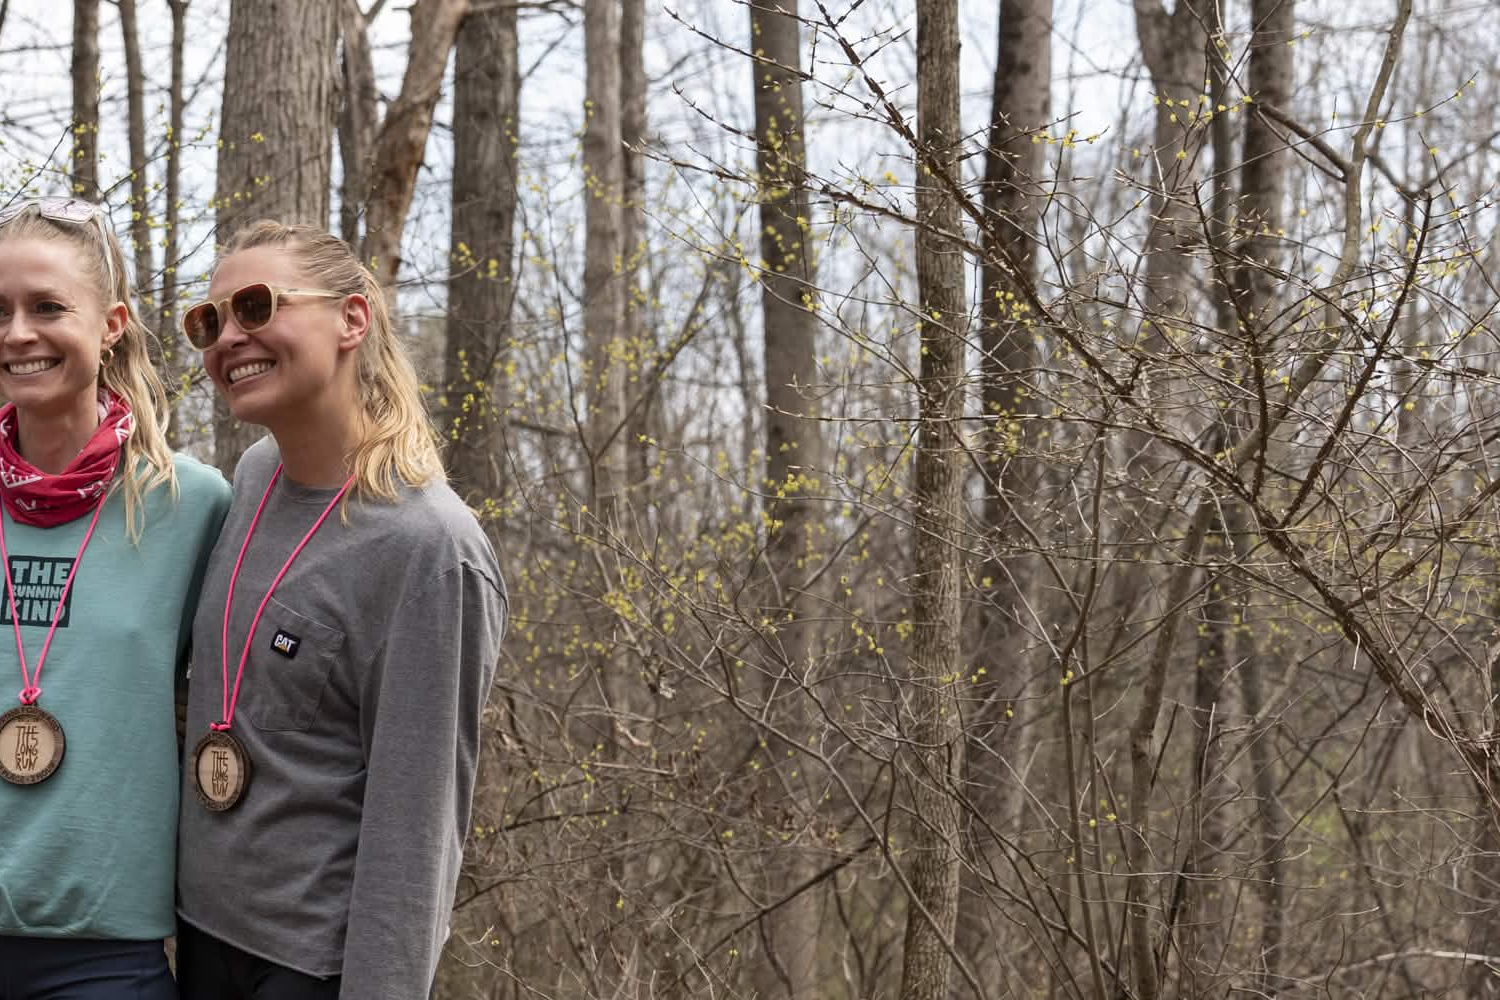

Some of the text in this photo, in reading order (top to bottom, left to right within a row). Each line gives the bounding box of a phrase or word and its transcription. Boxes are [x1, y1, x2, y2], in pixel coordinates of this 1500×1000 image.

[11, 560, 72, 585] THE
[5, 600, 66, 622] KIND
[274, 634, 297, 653] CAT
[15, 756, 38, 771] RUN
